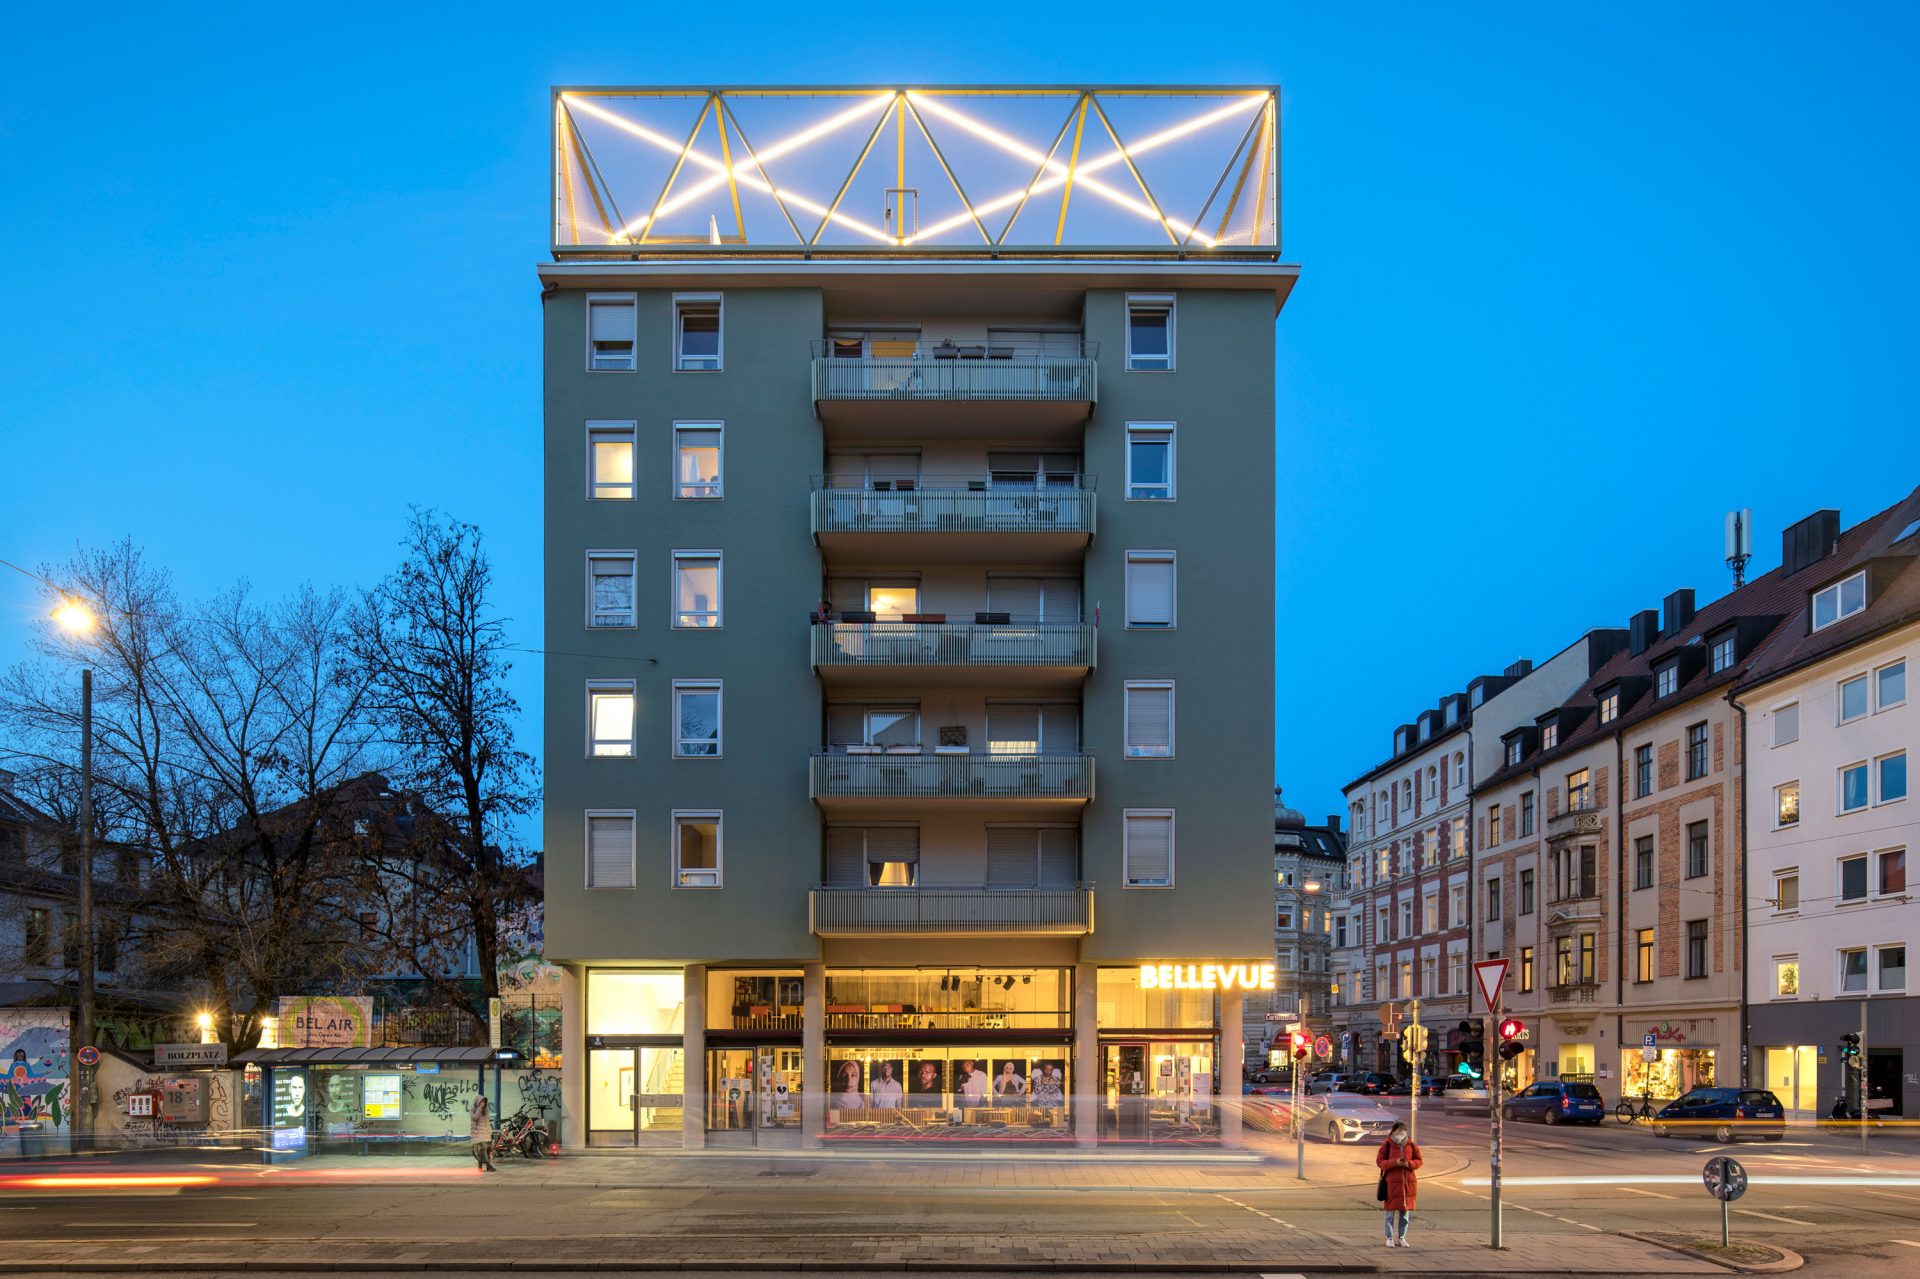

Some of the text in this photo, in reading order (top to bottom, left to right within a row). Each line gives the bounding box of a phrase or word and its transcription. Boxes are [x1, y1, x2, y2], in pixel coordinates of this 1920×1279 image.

[1140, 964, 1276, 989] BELLEVUE
[296, 1017, 353, 1031] BEL AIR
[1645, 1035, 1652, 1045] P
[167, 1051, 220, 1060] BOLZPLATZ
[168, 1091, 183, 1104] 18
